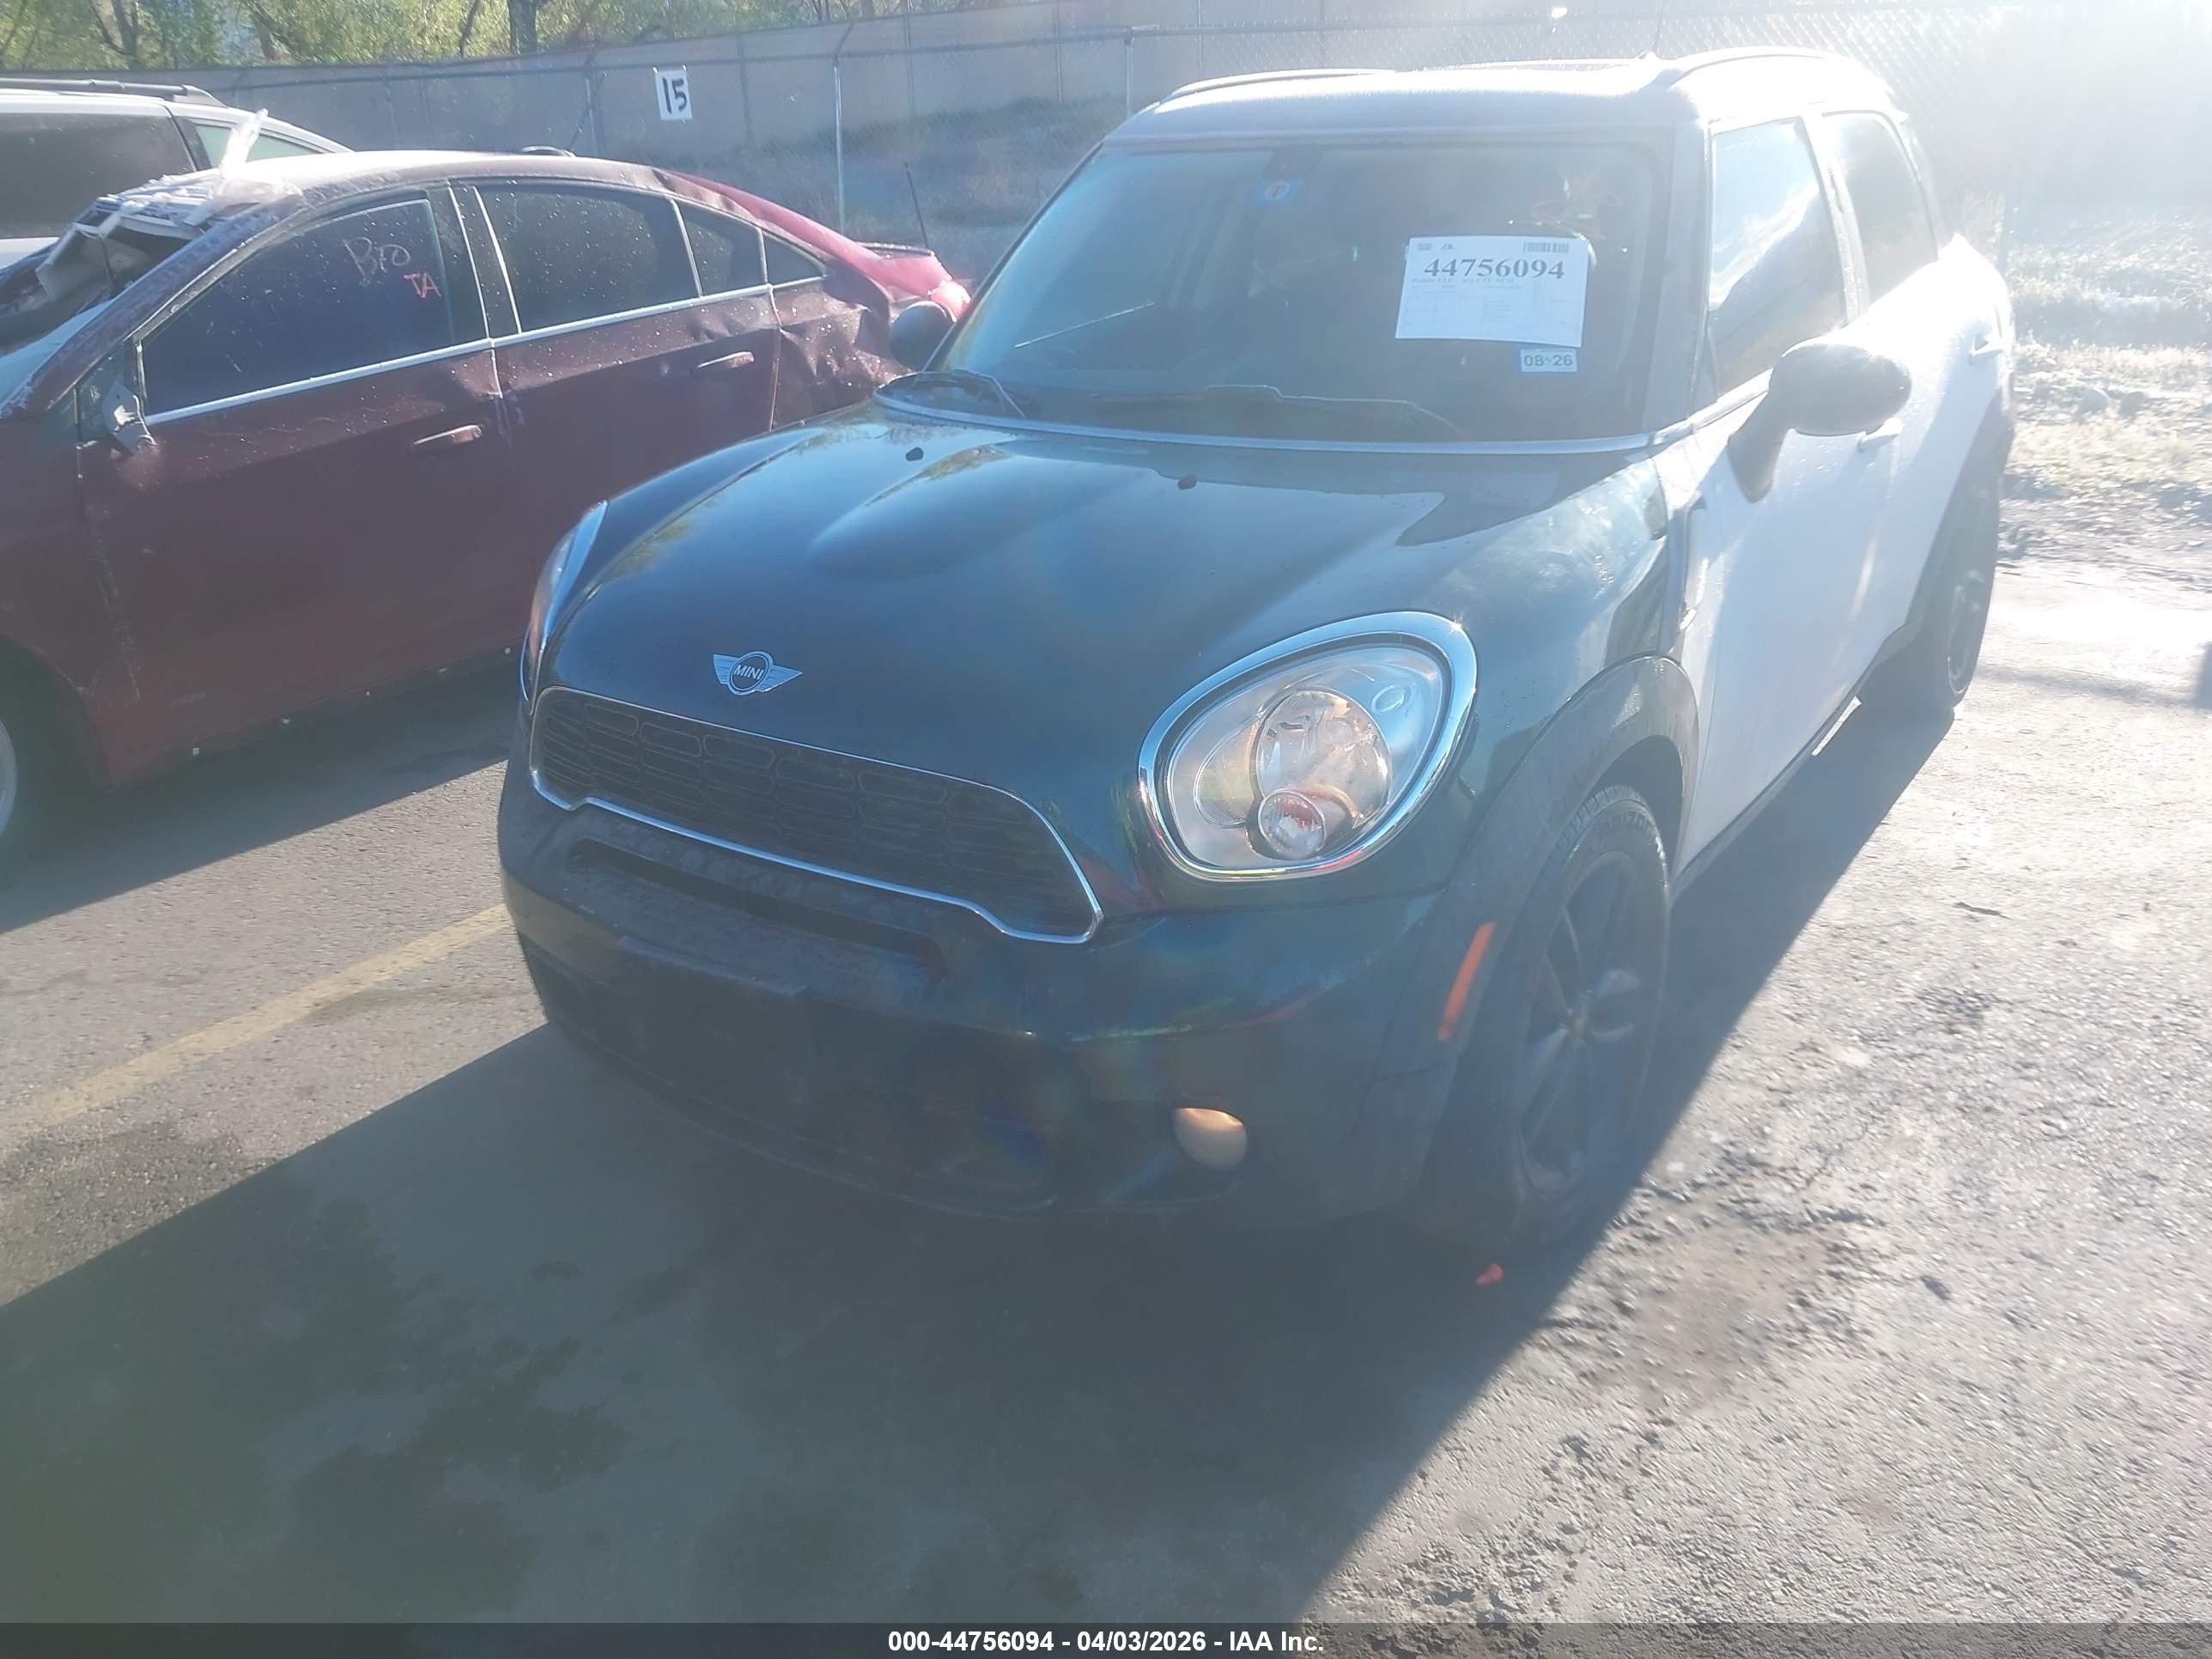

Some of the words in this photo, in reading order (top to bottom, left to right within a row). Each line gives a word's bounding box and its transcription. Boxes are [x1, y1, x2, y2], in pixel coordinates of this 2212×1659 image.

[662, 77, 687, 113] 15
[1424, 258, 1565, 279] 44756094
[733, 665, 764, 679] MINI
